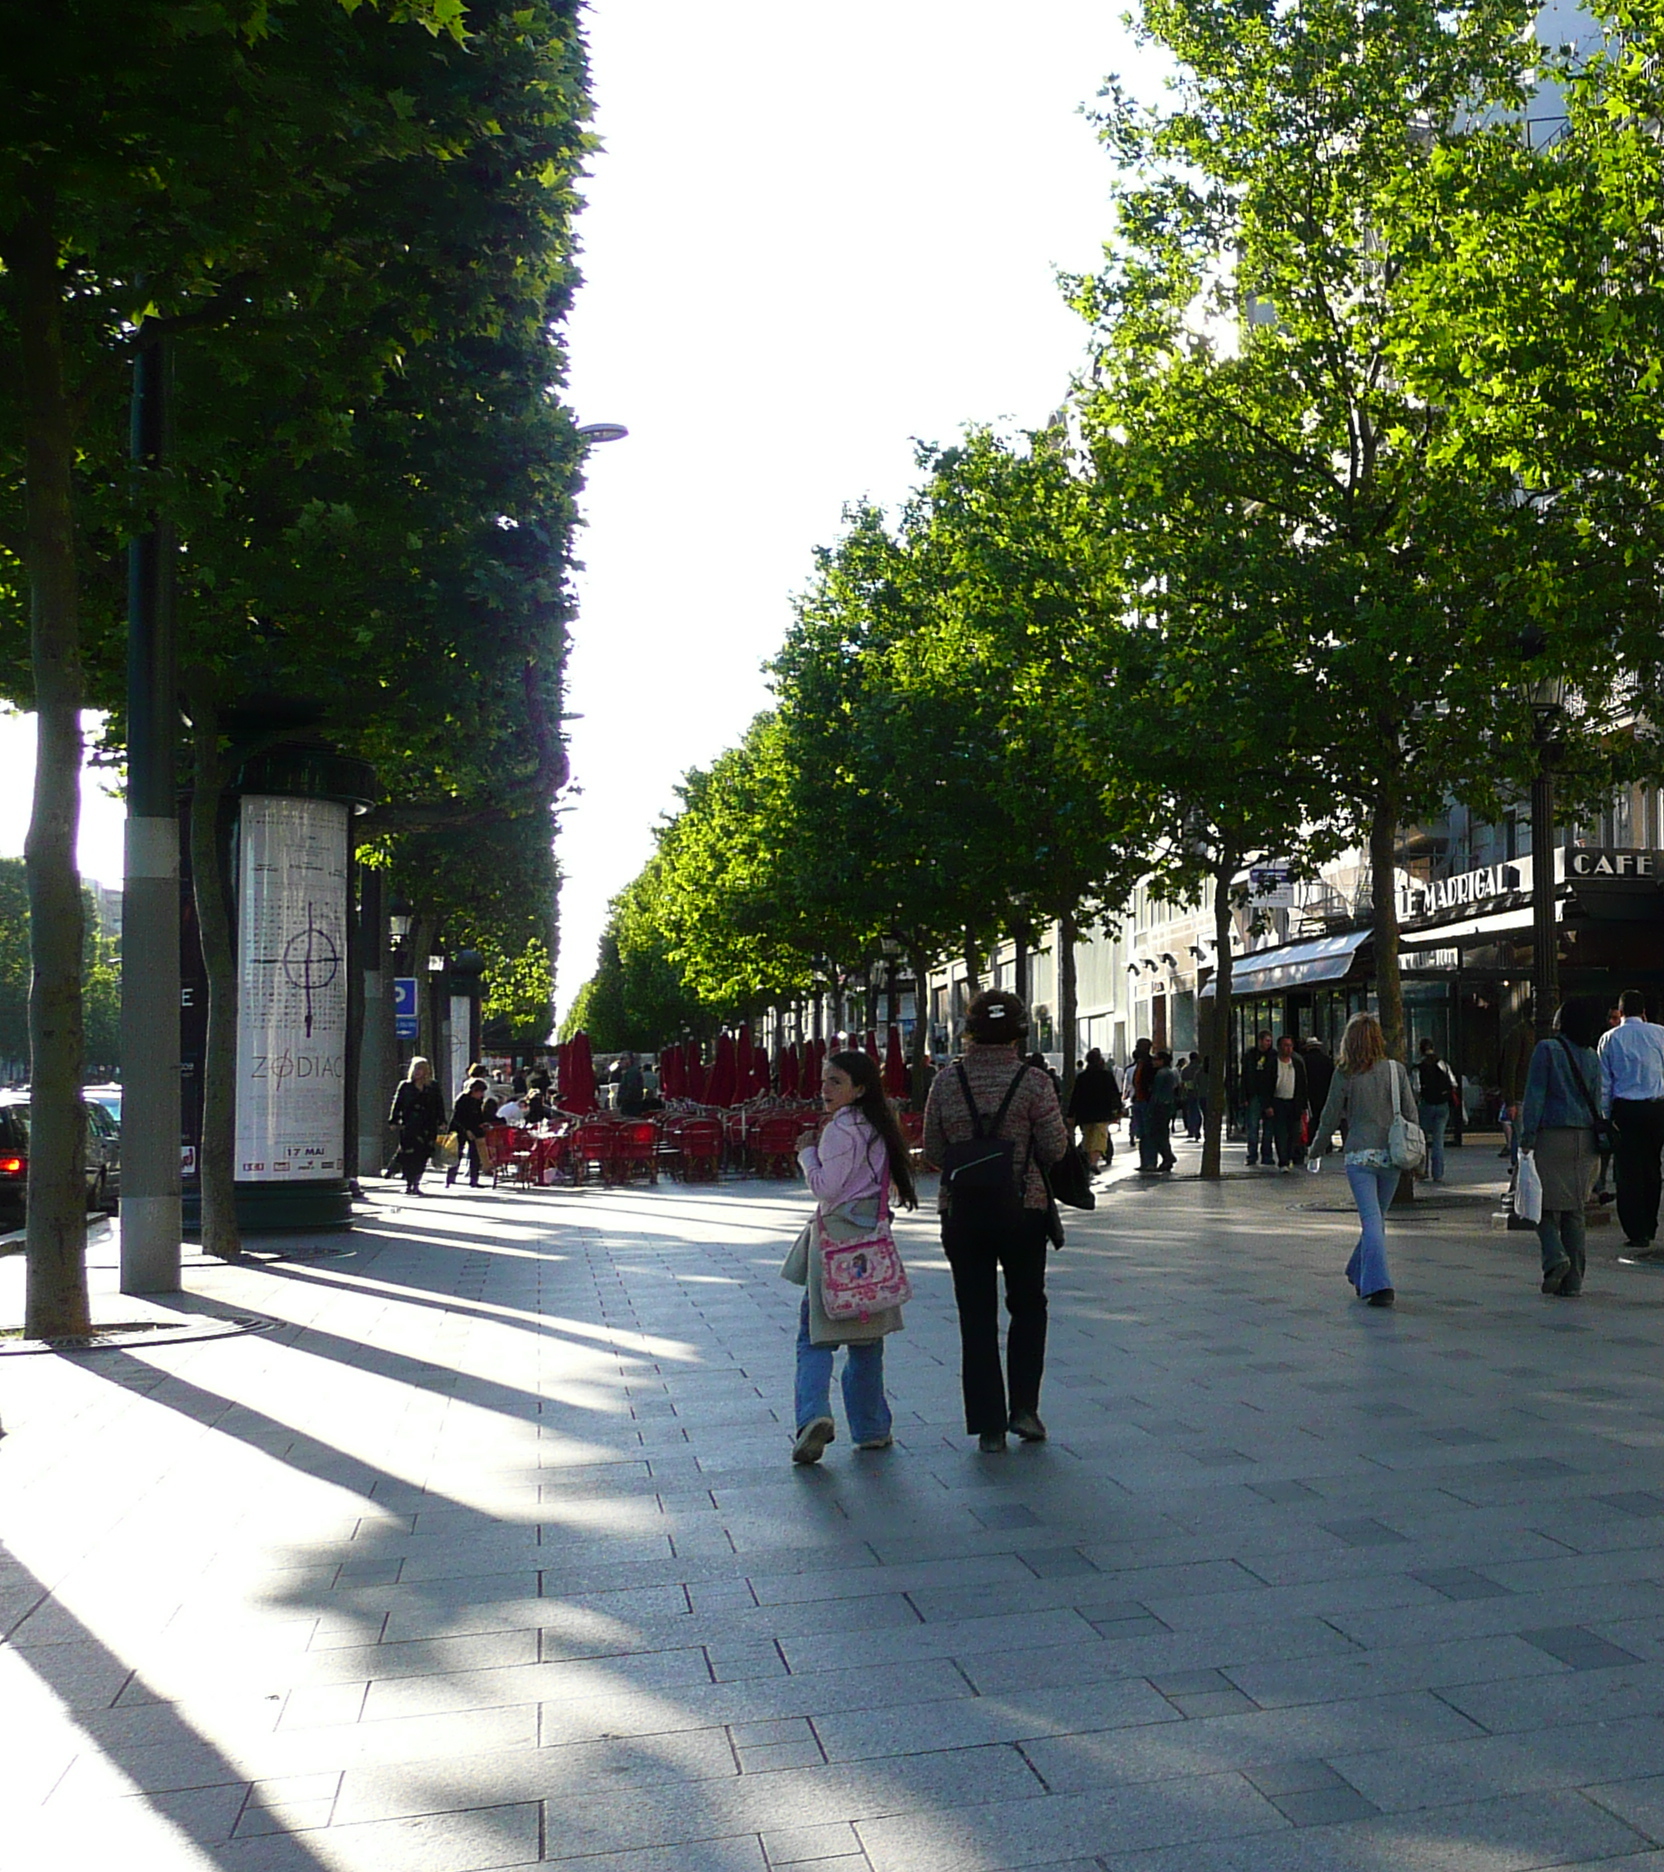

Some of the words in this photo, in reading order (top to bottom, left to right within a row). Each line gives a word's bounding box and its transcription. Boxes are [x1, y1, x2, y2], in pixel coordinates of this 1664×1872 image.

[1572, 853, 1654, 877] CAFE
[1423, 863, 1509, 917] MADRIGAL
[286, 1147, 302, 1157] 17
[304, 1147, 325, 1157] MAI
